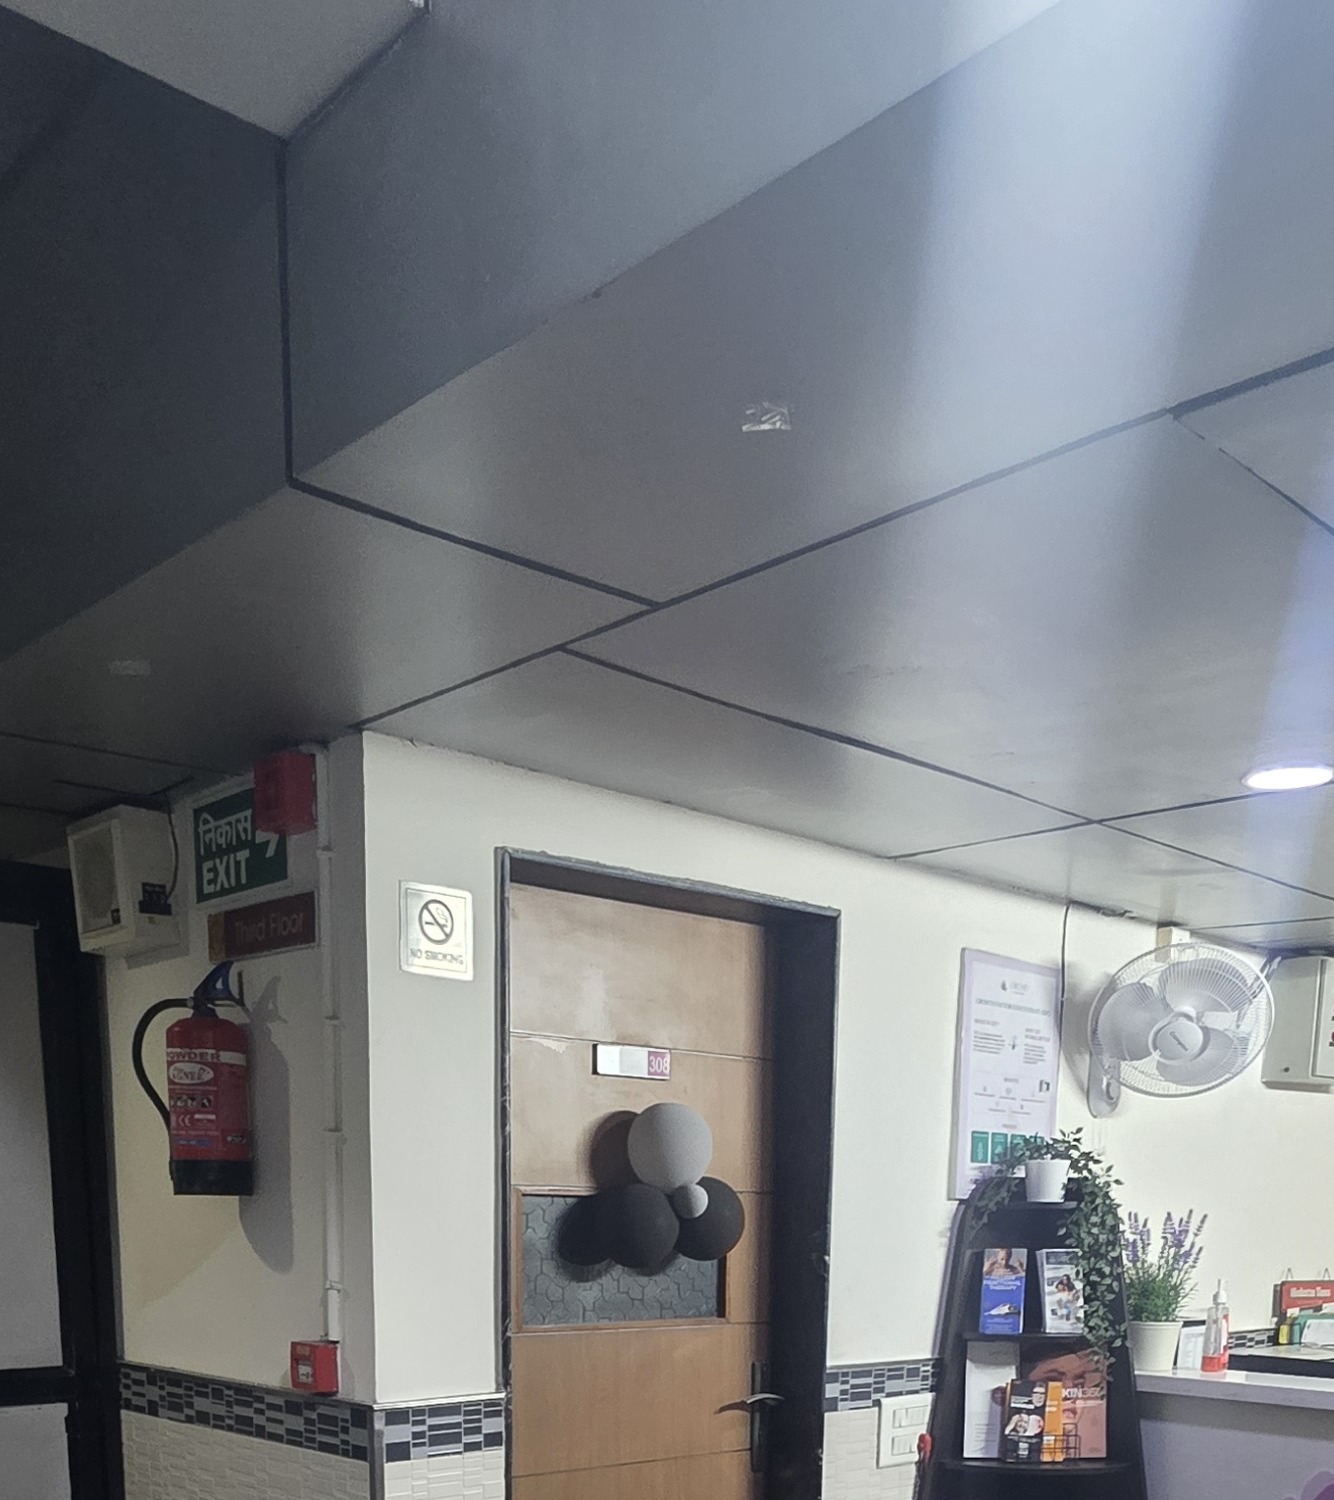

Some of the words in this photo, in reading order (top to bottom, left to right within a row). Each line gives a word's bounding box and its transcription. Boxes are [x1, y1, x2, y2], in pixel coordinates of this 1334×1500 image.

[198, 808, 253, 856] निकास
[202, 848, 250, 895] EXIT
[235, 915, 266, 945] Third
[269, 911, 304, 939] Floor
[167, 1051, 220, 1061] OWDER
[649, 1055, 670, 1074] 308
